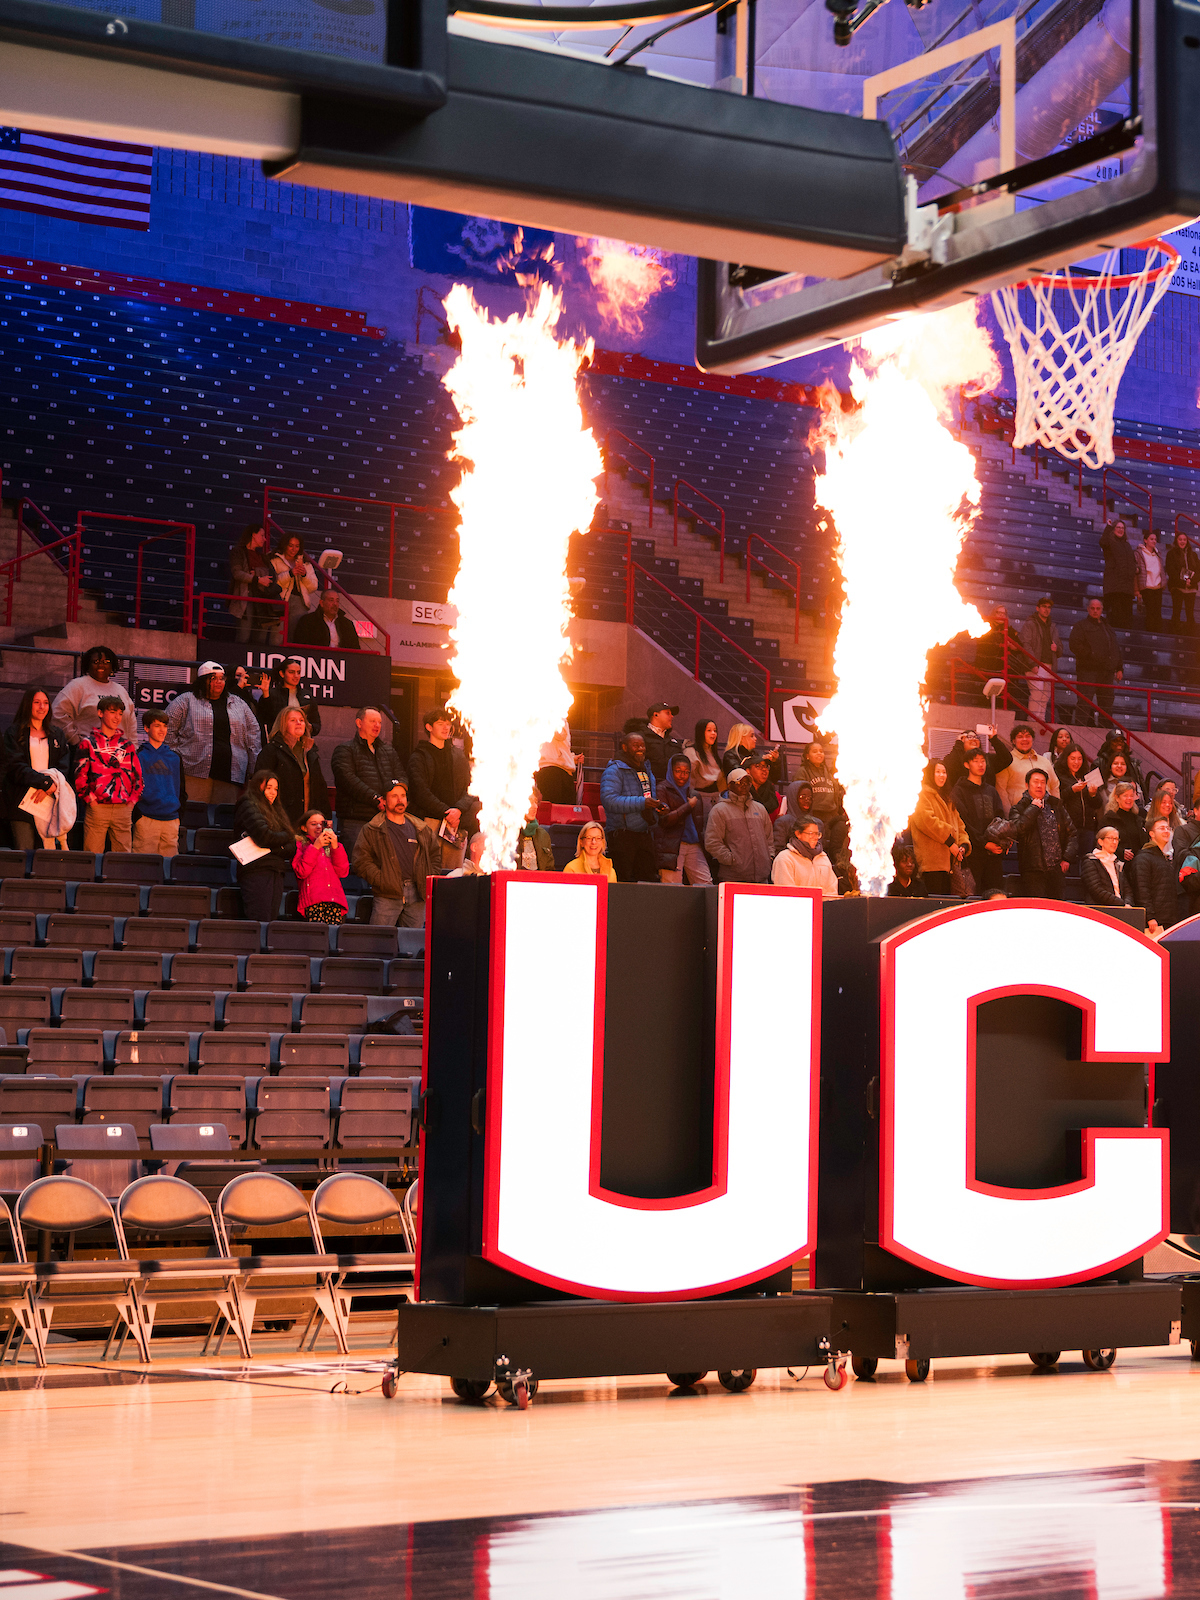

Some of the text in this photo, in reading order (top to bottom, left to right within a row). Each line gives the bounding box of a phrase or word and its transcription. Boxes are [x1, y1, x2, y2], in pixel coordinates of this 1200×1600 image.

[1191, 245, 1197, 256] 4
[1171, 275, 1186, 288] 005
[1187, 277, 1200, 291] Hall
